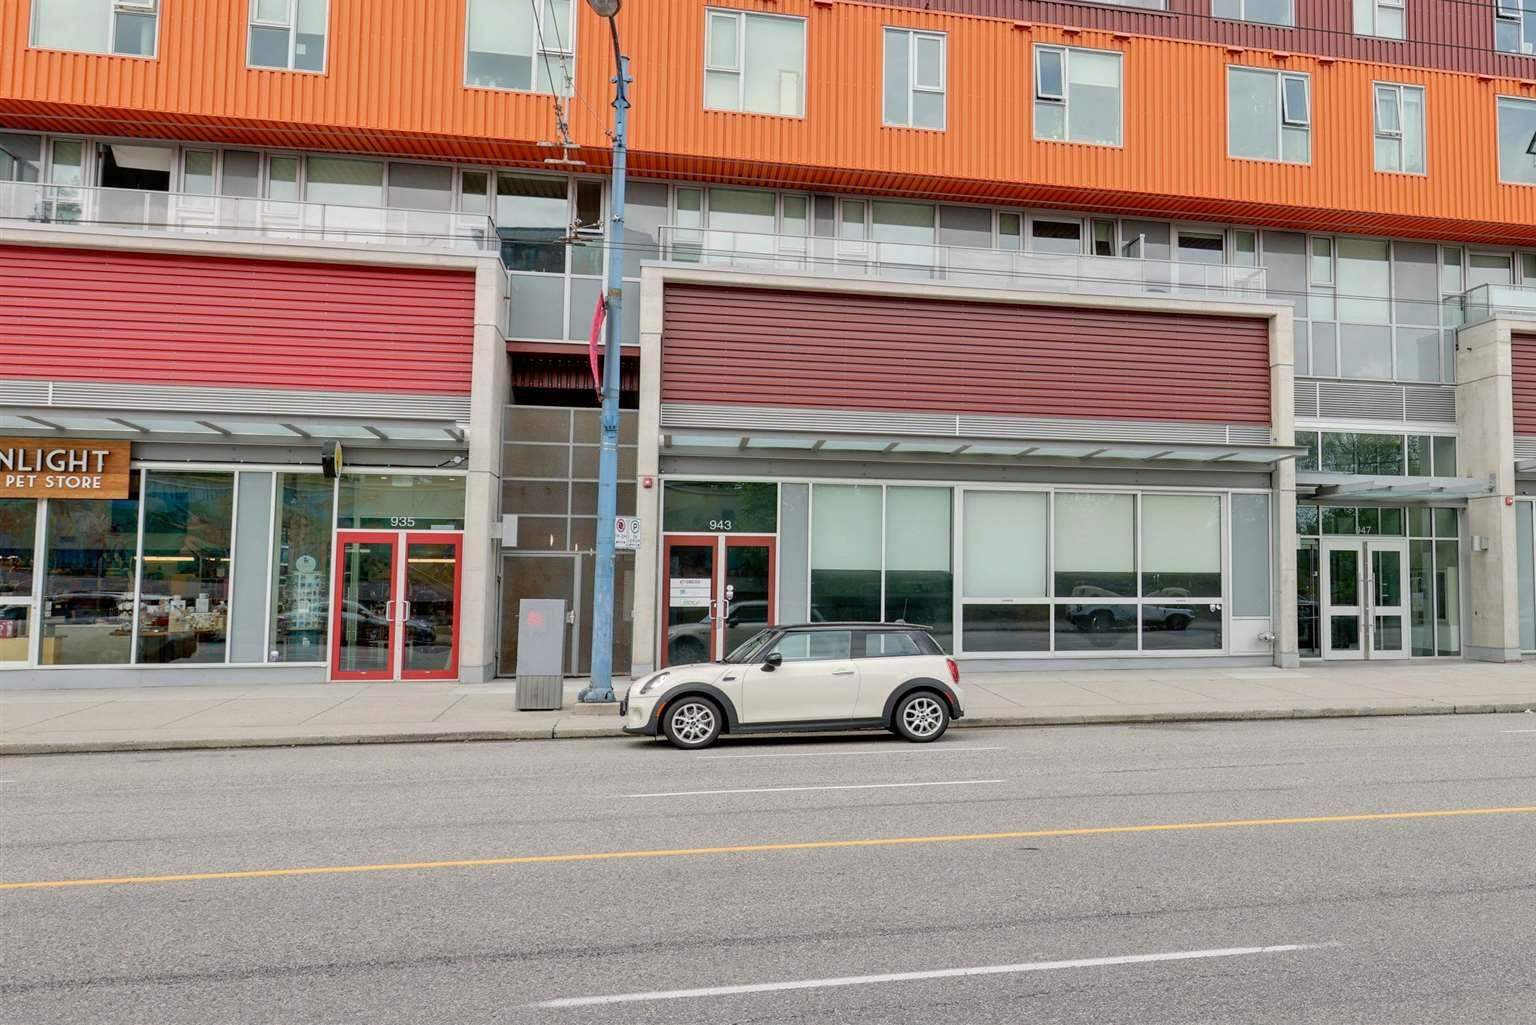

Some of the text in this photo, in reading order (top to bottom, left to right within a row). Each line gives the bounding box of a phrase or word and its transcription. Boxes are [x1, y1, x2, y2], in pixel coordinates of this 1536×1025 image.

[0, 448, 110, 472] NLIGHT
[6, 475, 102, 489] PET STORE
[390, 516, 415, 527] 935
[709, 519, 732, 530] 943
